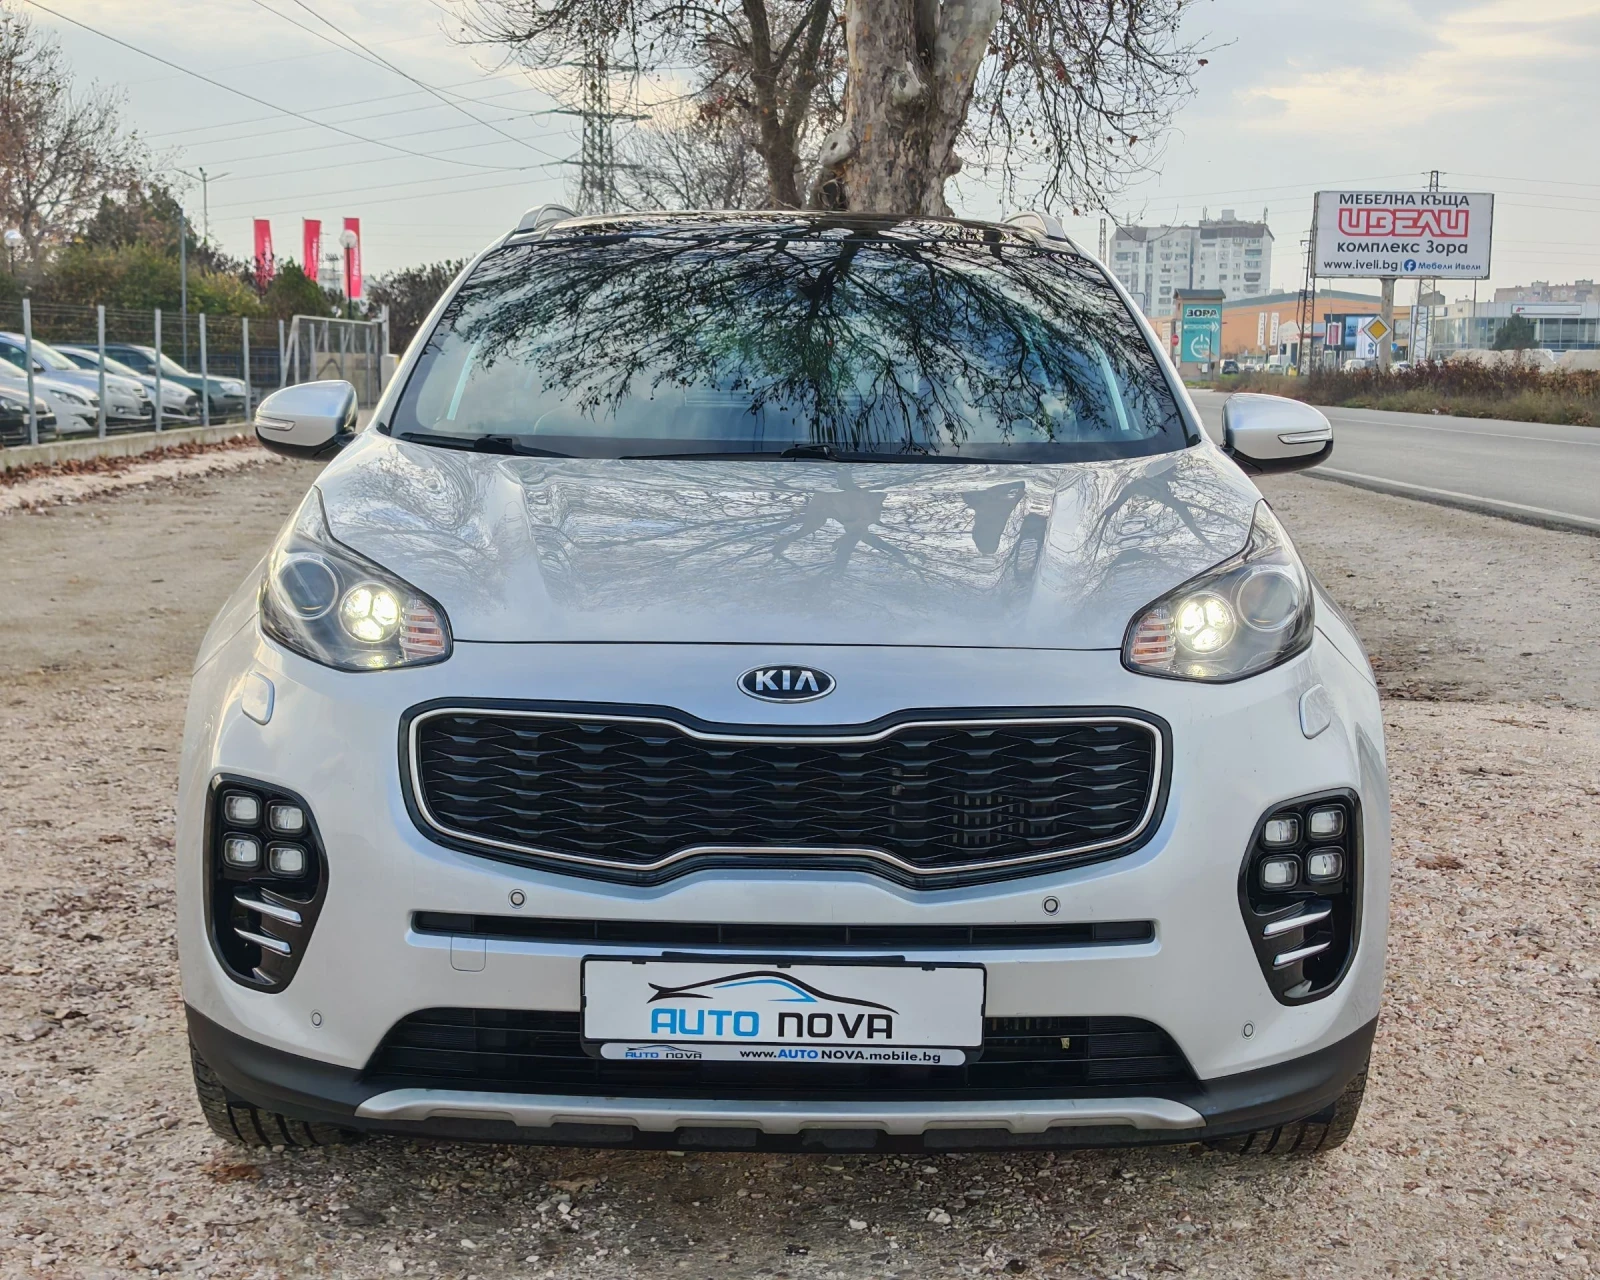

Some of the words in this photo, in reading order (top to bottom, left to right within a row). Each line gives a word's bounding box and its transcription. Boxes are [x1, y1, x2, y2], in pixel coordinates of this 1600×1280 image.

[1339, 193, 1416, 205] МЕБЕЛНА
[1421, 194, 1470, 208] КЪЩА
[1338, 208, 1470, 238] ИВЕЛИ
[1426, 239, 1468, 256] Зора
[1323, 259, 1398, 272] www.iveli.bg
[1418, 262, 1452, 270] Мебели
[1455, 262, 1481, 271] Ивели
[1186, 308, 1219, 318] ЗОРА
[755, 669, 819, 692] KIA
[651, 1008, 759, 1037] AUTO
[777, 1012, 894, 1039] NOVA
[625, 1051, 659, 1059] AUTO
[665, 1052, 702, 1060] NOVA
